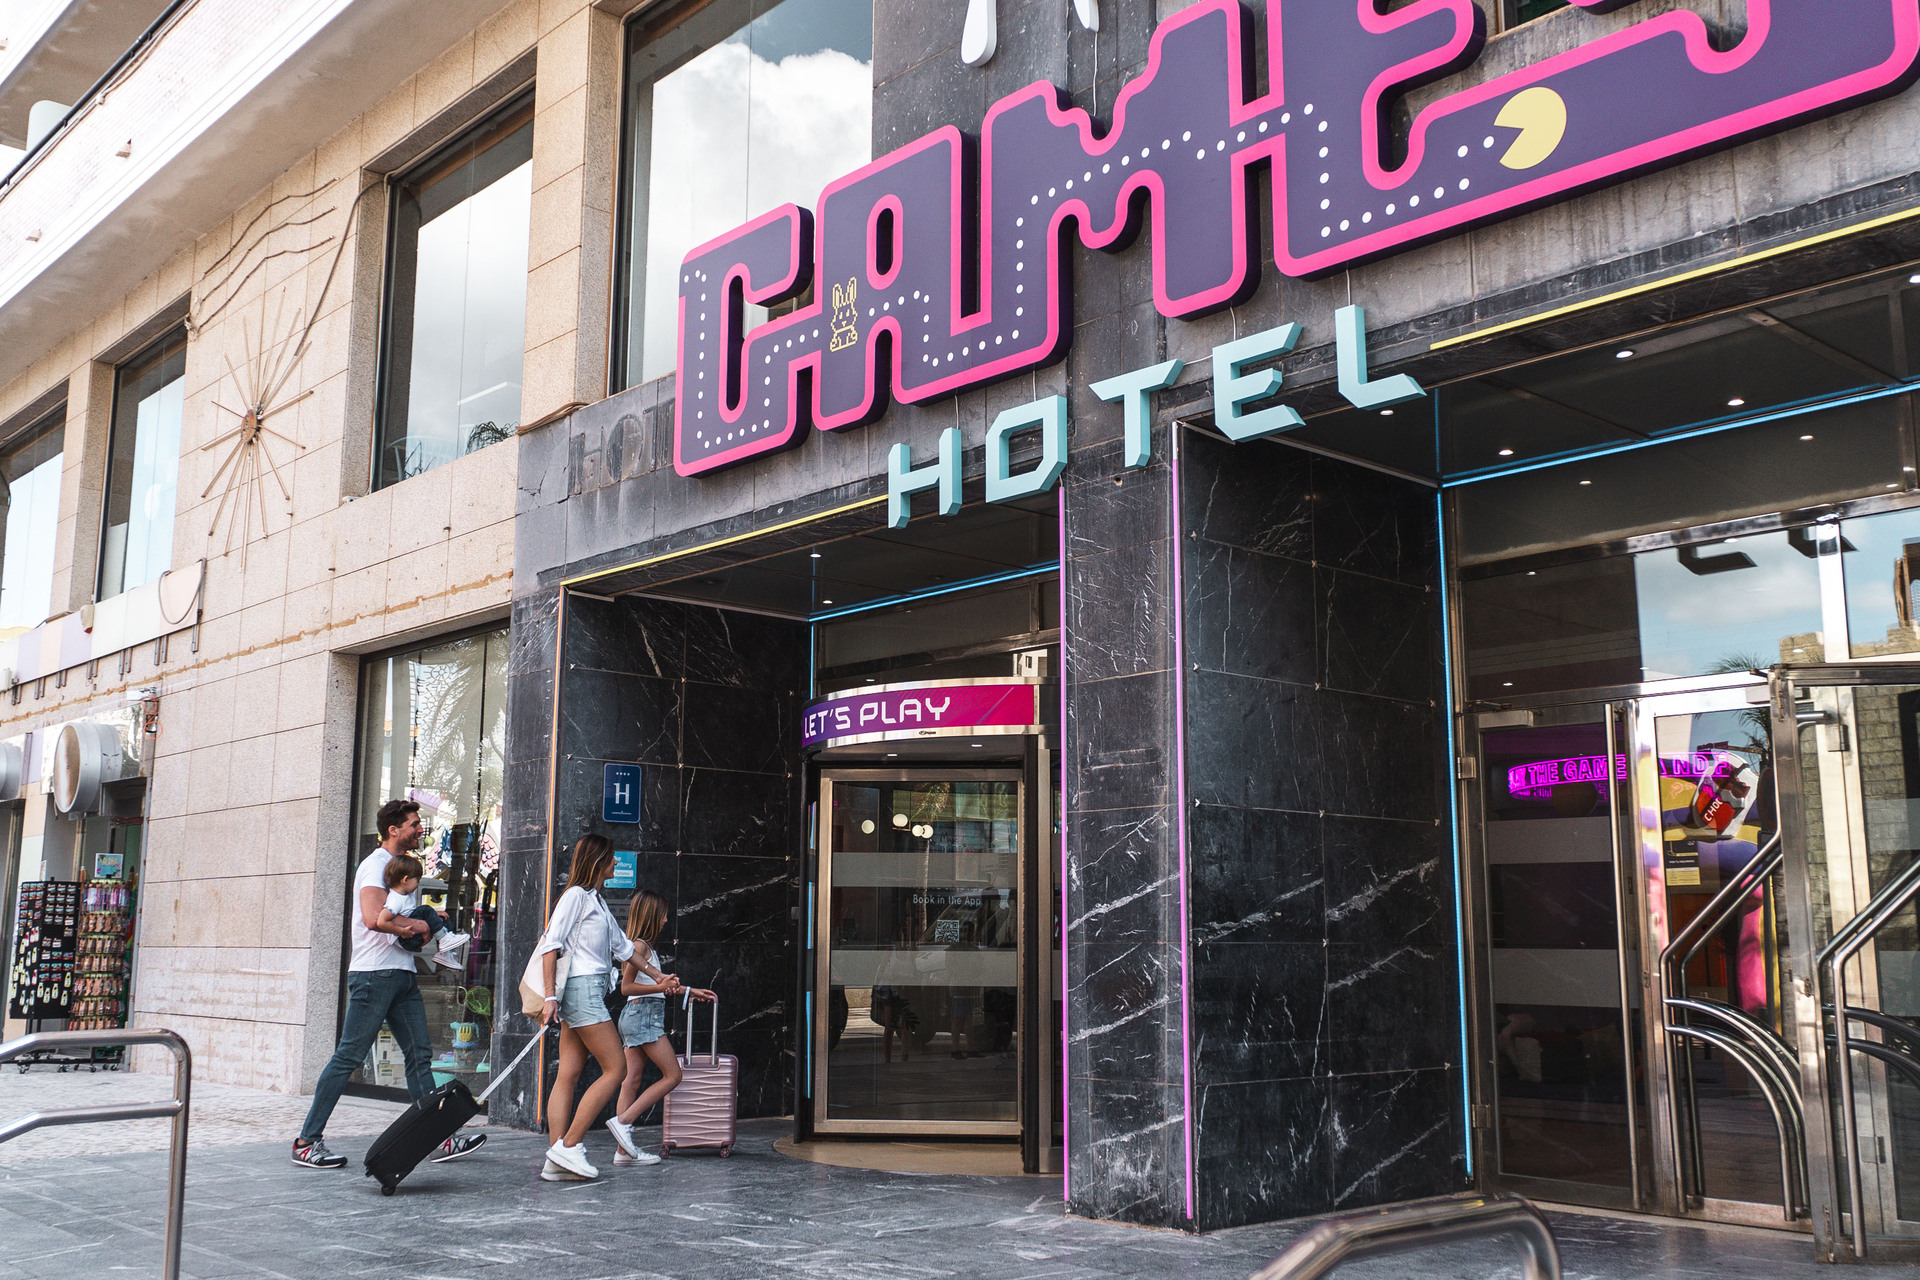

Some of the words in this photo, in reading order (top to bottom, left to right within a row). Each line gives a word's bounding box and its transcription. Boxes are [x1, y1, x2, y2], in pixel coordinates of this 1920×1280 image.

[886, 303, 1428, 530] HOTEL
[804, 705, 851, 739] LET'S
[859, 696, 951, 727] PLAY
[1528, 762, 1559, 785] THE
[912, 893, 935, 904] Book
[936, 895, 945, 904] in
[948, 895, 962, 905] the
[964, 896, 982, 907] App
